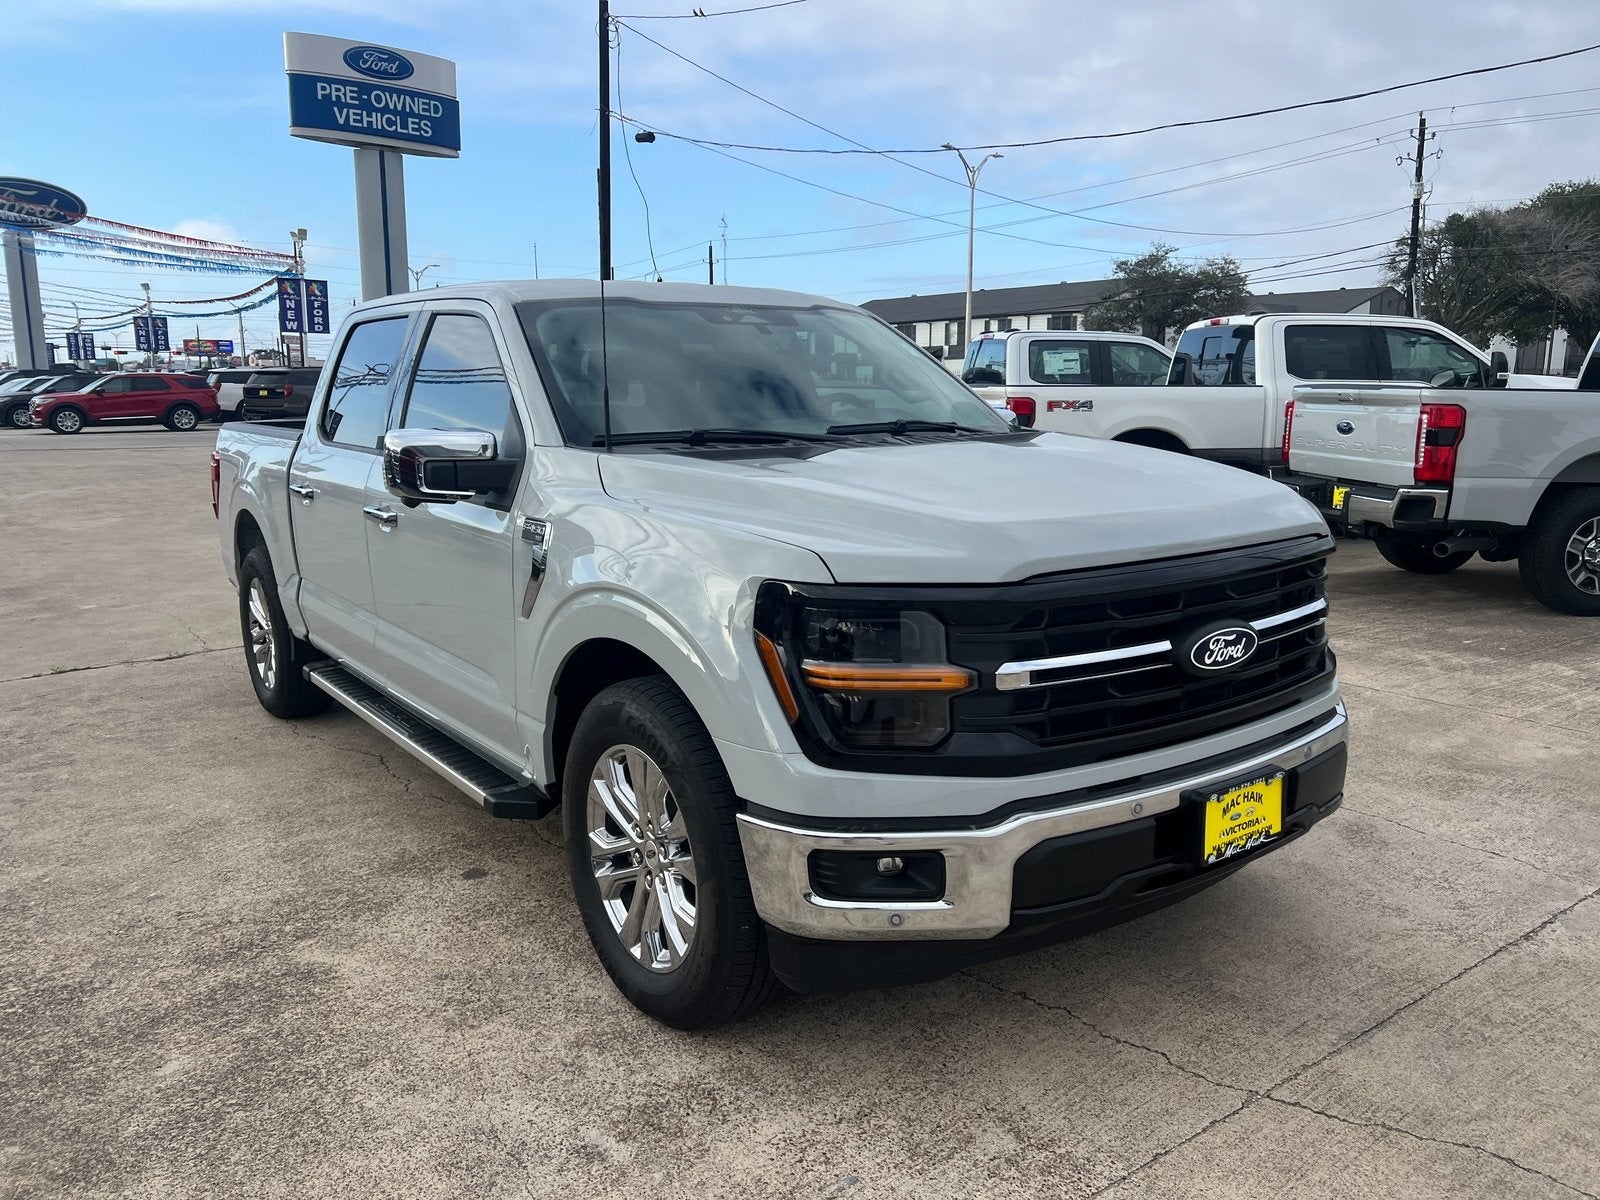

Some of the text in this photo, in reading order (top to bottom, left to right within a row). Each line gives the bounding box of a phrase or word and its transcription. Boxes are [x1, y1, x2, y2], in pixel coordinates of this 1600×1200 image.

[358, 50, 400, 74] Ford
[333, 106, 433, 137] VEHICLES
[285, 299, 298, 330] NEW
[313, 301, 324, 332] FORD
[138, 330, 148, 349] NEW
[157, 330, 166, 350] FORD
[1046, 400, 1094, 412] FX4
[1204, 633, 1245, 665] Ford
[1221, 793, 1242, 819] MAC
[1242, 790, 1264, 806] HAIK
